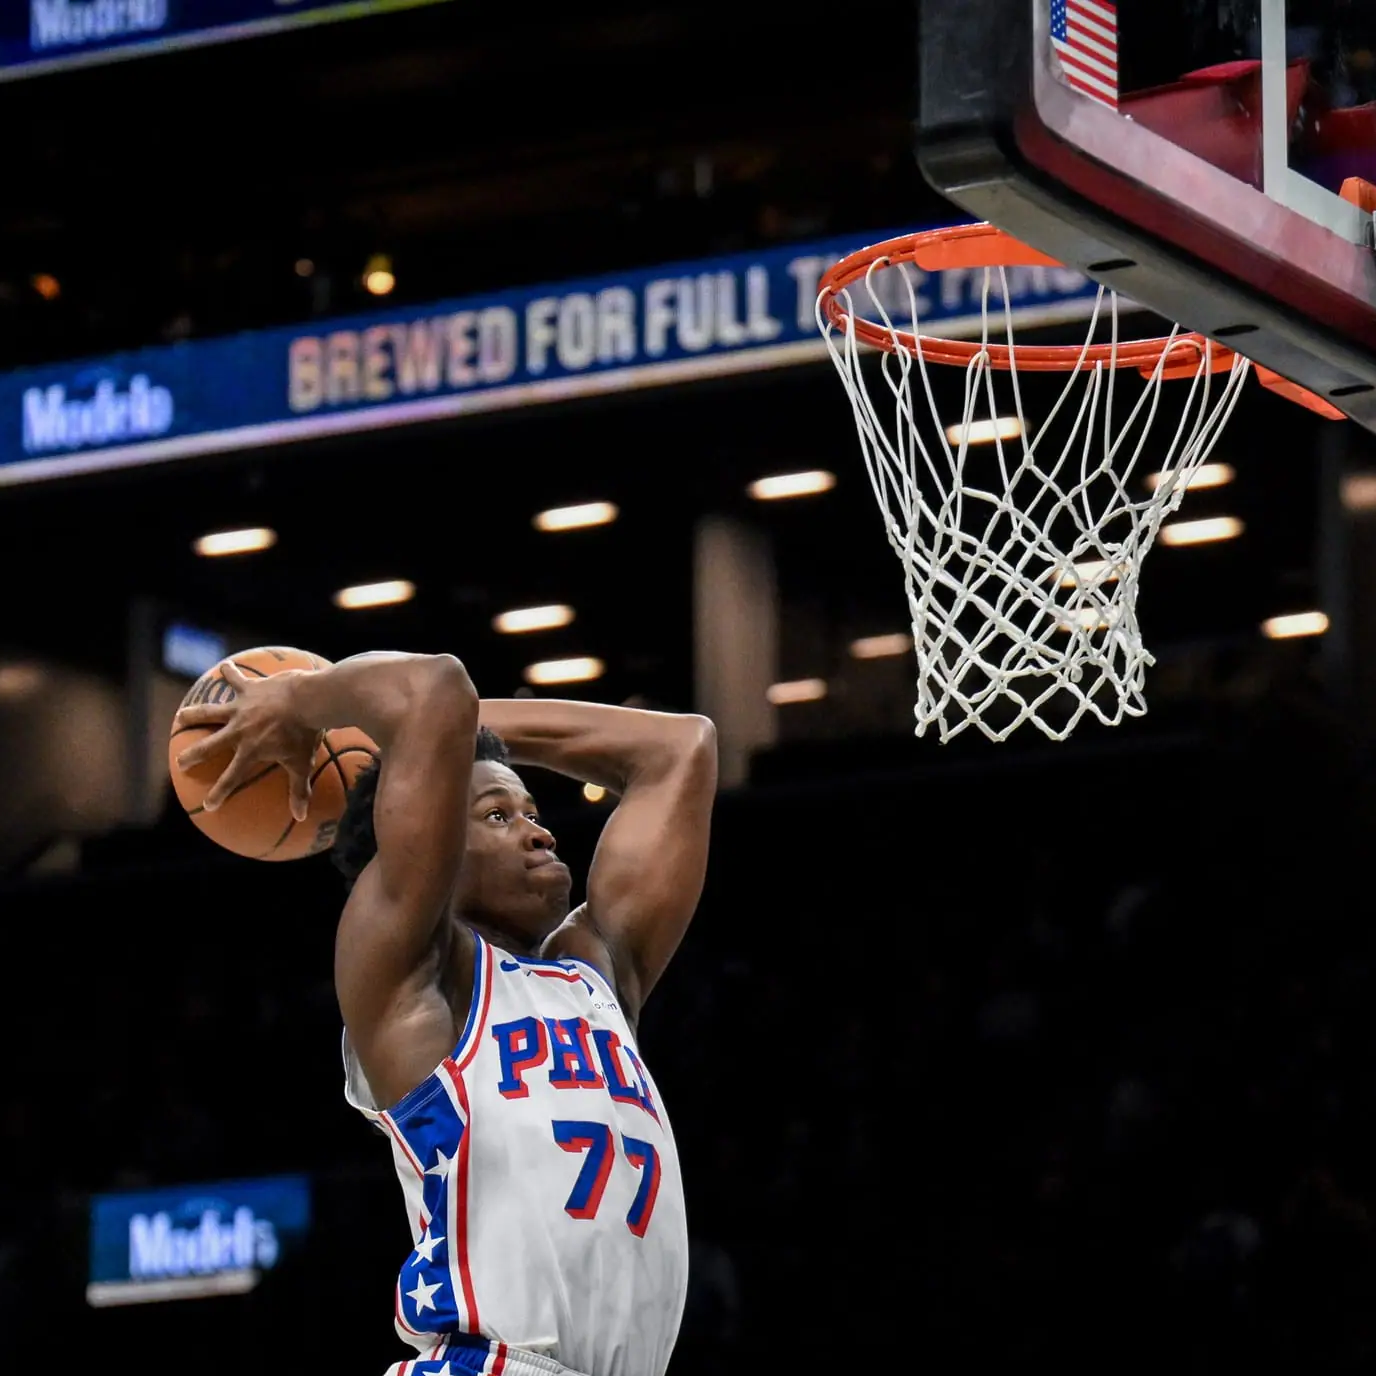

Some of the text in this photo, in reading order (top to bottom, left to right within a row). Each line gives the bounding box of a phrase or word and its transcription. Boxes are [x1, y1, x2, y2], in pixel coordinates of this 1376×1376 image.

[289, 305, 516, 412] BREWED
[525, 290, 636, 374] FOR
[644, 268, 782, 358] FULL
[22, 374, 173, 454] Modelo
[551, 1120, 662, 1239] 77
